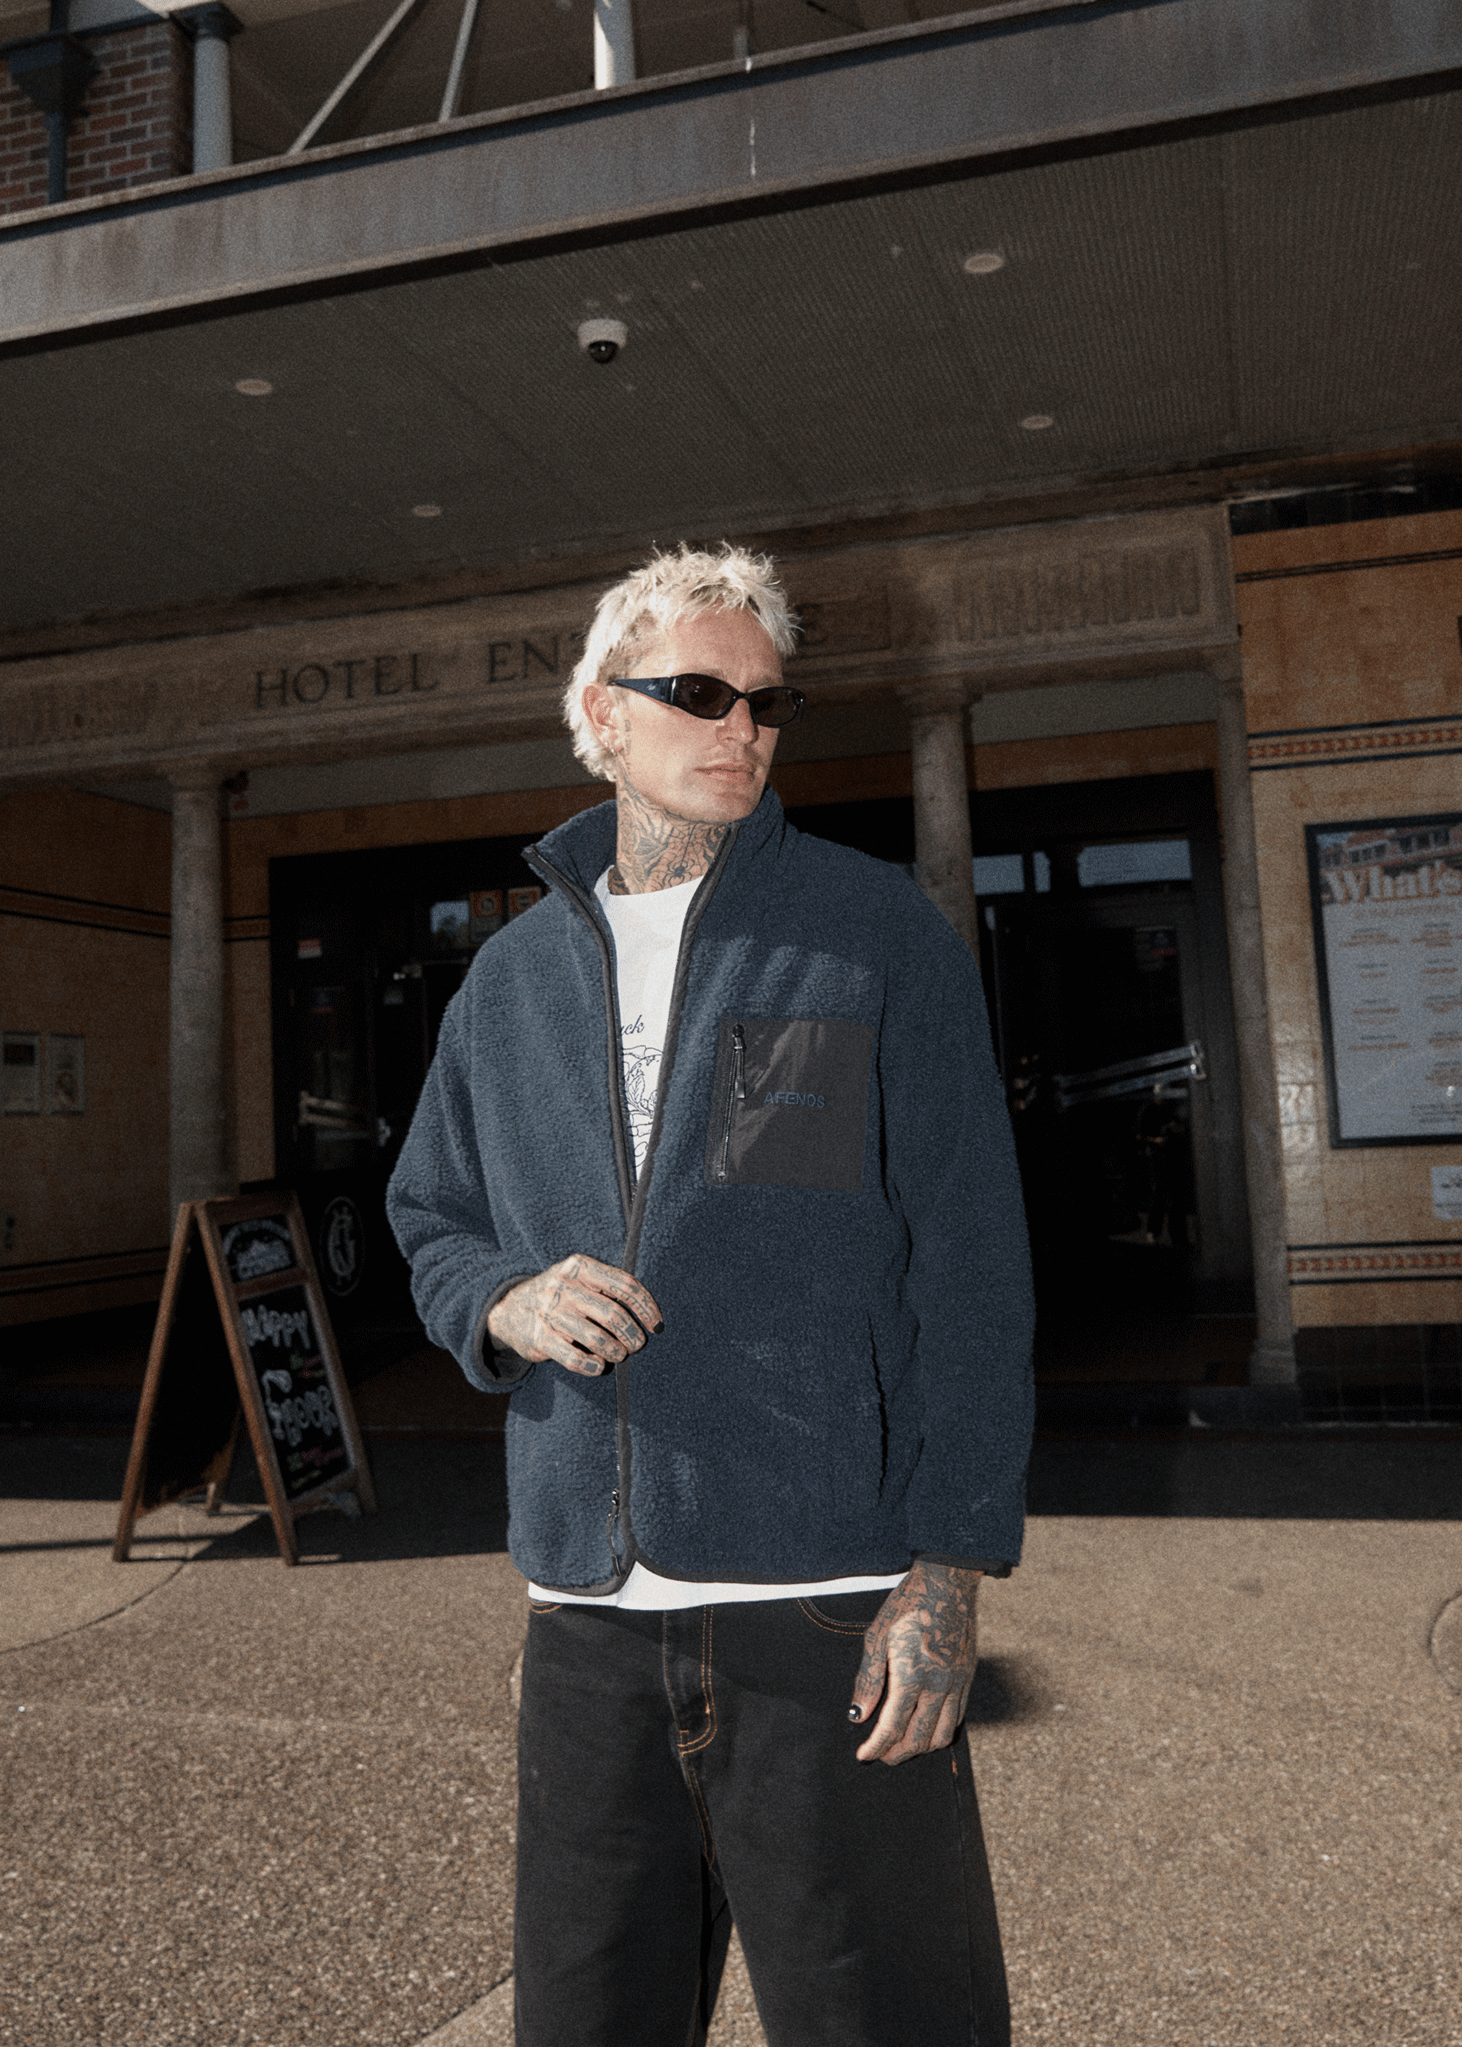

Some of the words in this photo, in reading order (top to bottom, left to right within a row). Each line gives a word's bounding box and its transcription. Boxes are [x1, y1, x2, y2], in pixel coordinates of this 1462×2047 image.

[255, 652, 438, 709] HOTEL
[1322, 860, 1461, 903] What's
[762, 1091, 827, 1110] AFENDS
